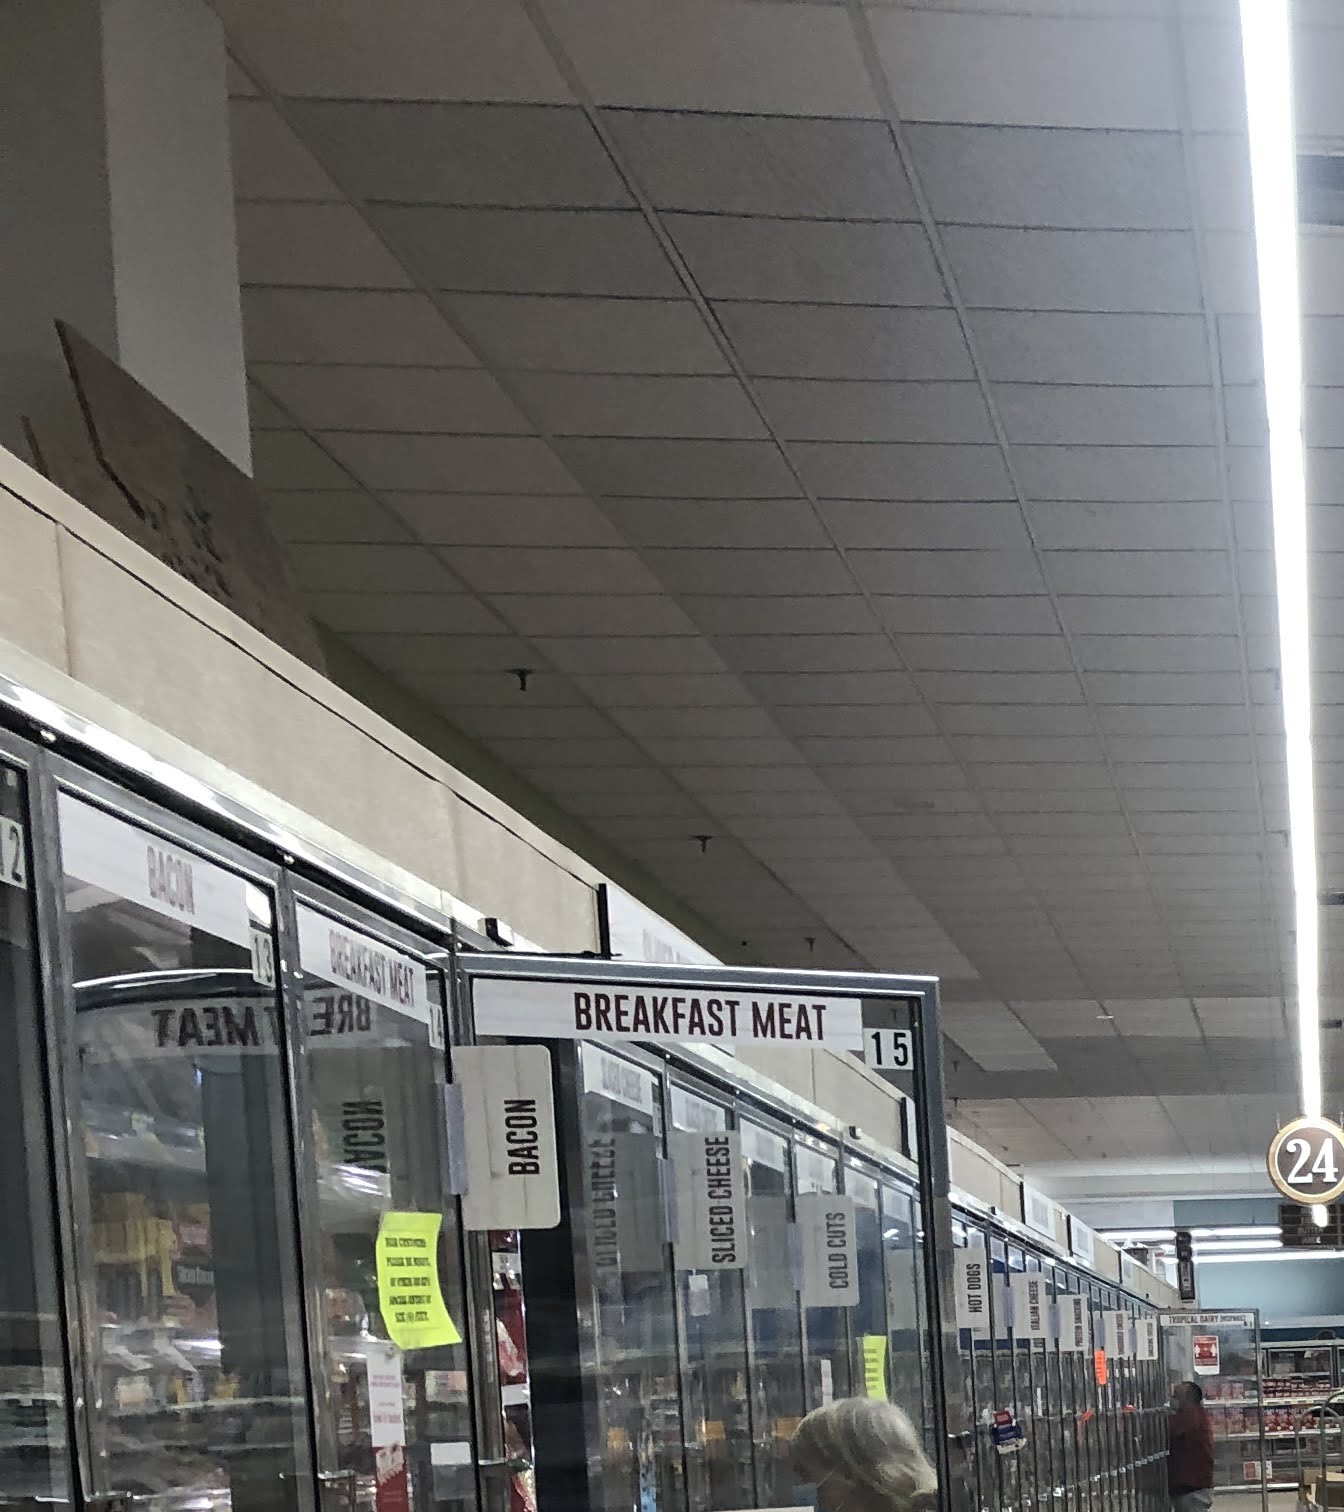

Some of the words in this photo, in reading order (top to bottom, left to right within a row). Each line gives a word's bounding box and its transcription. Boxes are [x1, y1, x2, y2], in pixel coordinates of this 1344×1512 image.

[574, 991, 739, 1037] BREAKFAST
[752, 1002, 826, 1041] MEAT
[871, 1031, 909, 1068] 15
[503, 1099, 540, 1176] BACON
[705, 1136, 733, 1200] CHEESE
[1286, 1138, 1339, 1184] 24
[708, 1205, 736, 1264] SLICED
[825, 1212, 846, 1249] CUTS
[828, 1254, 849, 1290] COLD
[966, 1263, 981, 1291] DOGS
[968, 1293, 982, 1313] HOT
